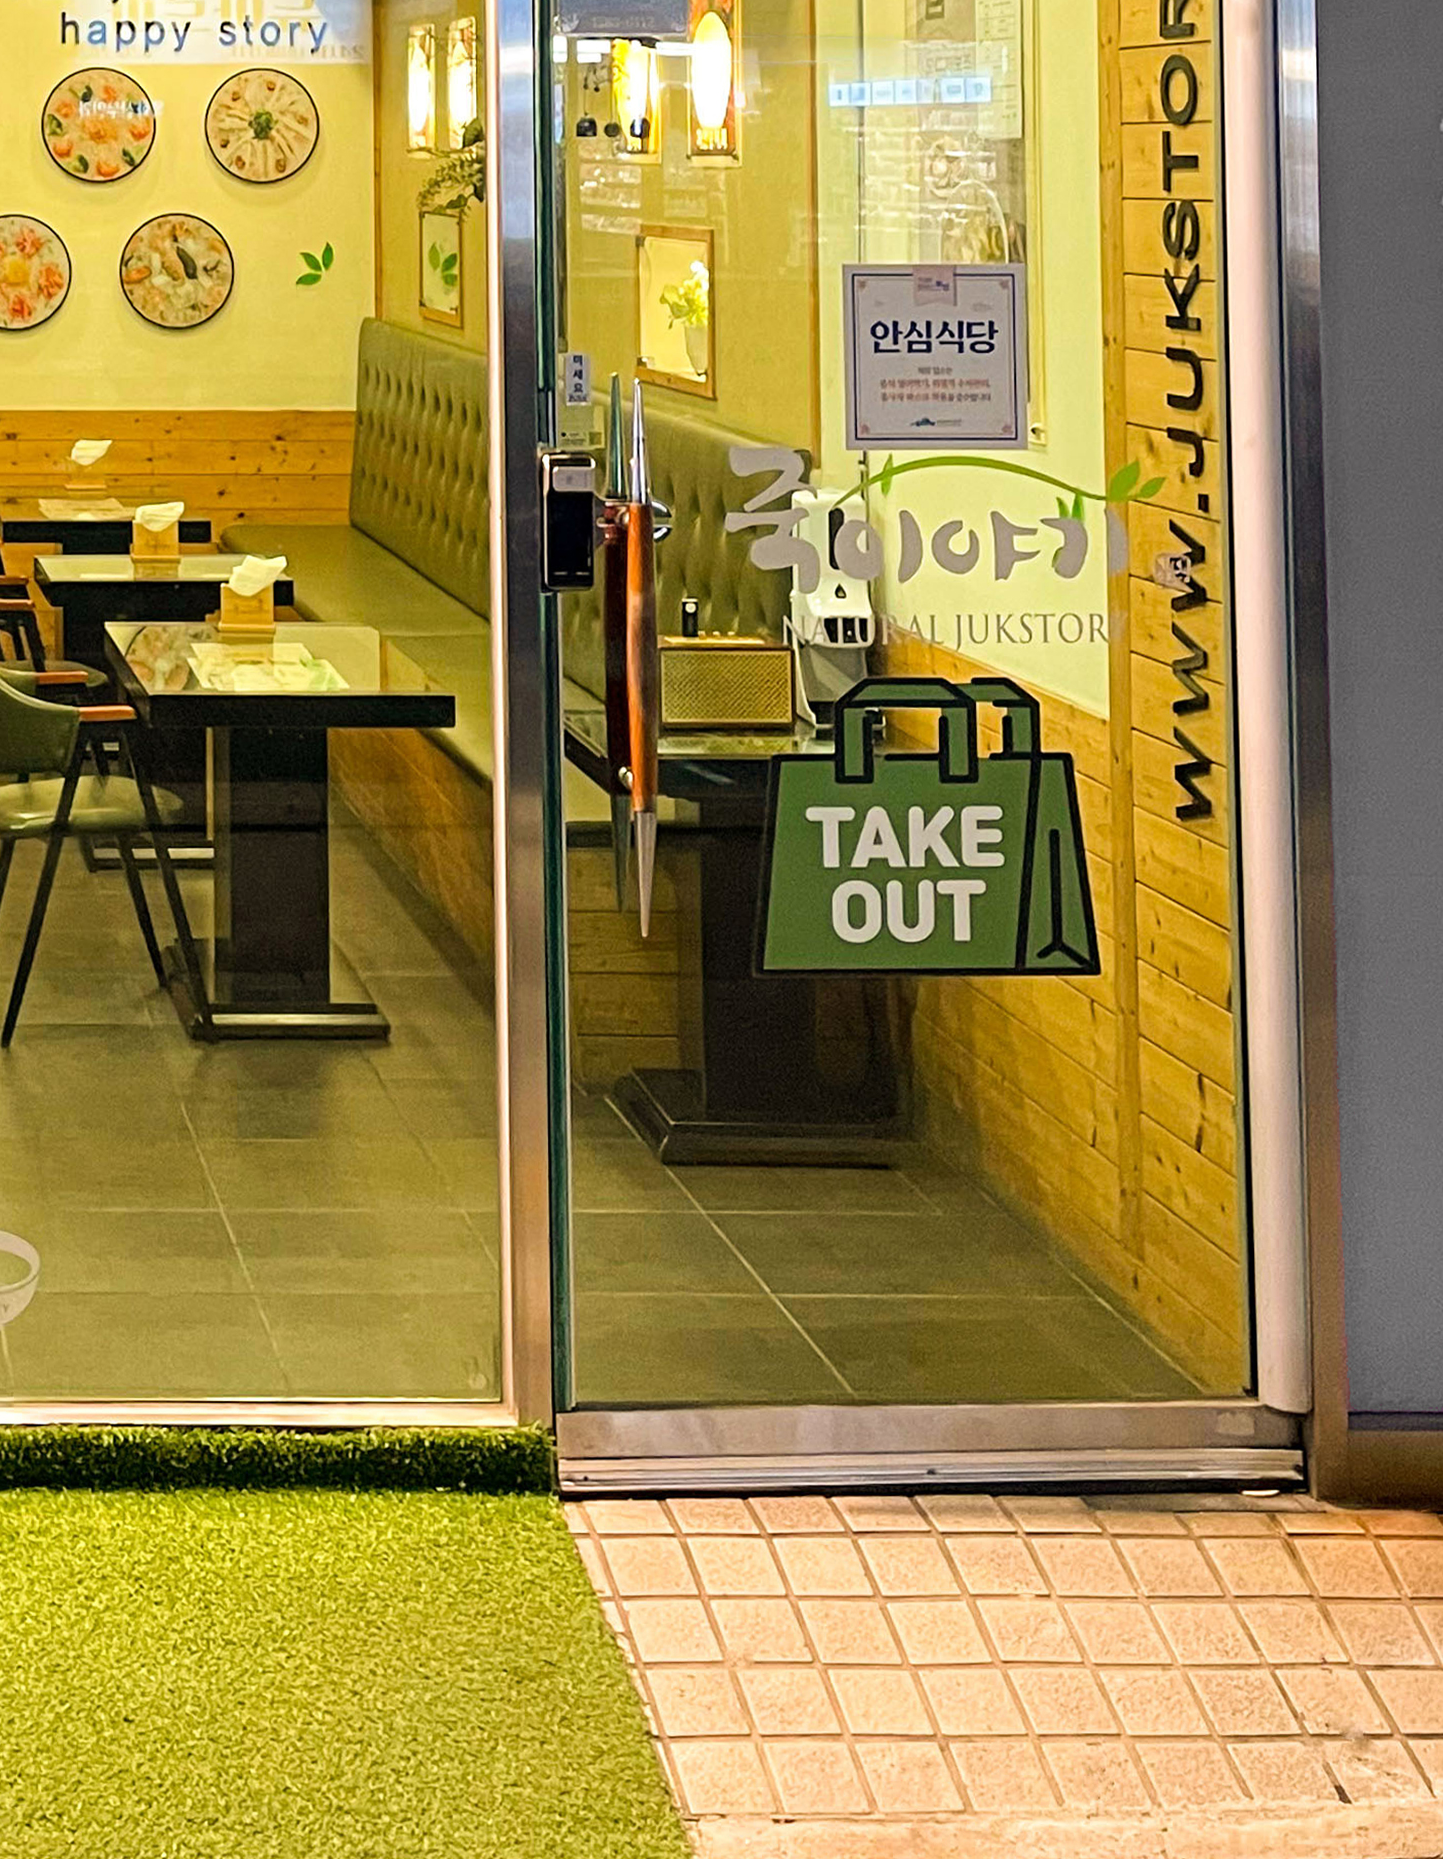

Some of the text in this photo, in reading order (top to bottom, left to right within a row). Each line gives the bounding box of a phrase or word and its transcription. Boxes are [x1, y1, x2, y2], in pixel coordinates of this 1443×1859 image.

[61, 11, 192, 53] happy
[218, 15, 328, 53] story
[870, 320, 999, 355] 안심식당
[724, 447, 1128, 594] 죽이야기
[954, 613, 1110, 651] JUKSTOR
[805, 805, 1006, 869] TAKE
[831, 880, 987, 944] OUT
